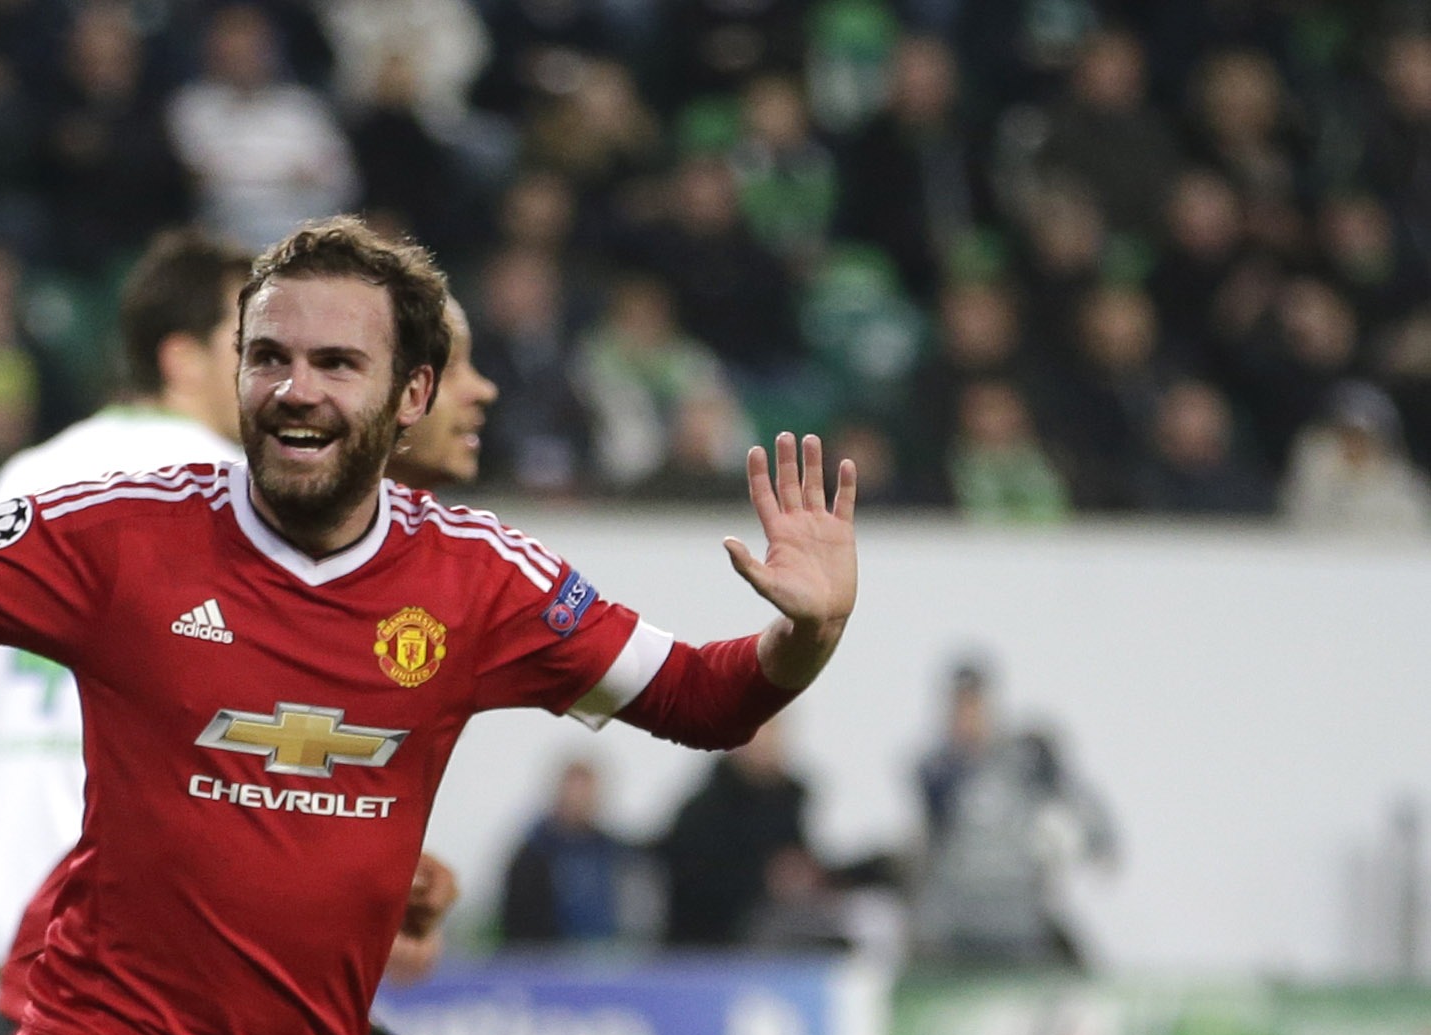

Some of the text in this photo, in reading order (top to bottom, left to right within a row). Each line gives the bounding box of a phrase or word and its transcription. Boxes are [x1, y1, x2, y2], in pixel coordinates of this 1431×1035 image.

[171, 620, 235, 644] adidas
[380, 611, 441, 638] MANCHESTER
[390, 665, 431, 681] UNITED
[187, 773, 398, 820] CHEVROLET
